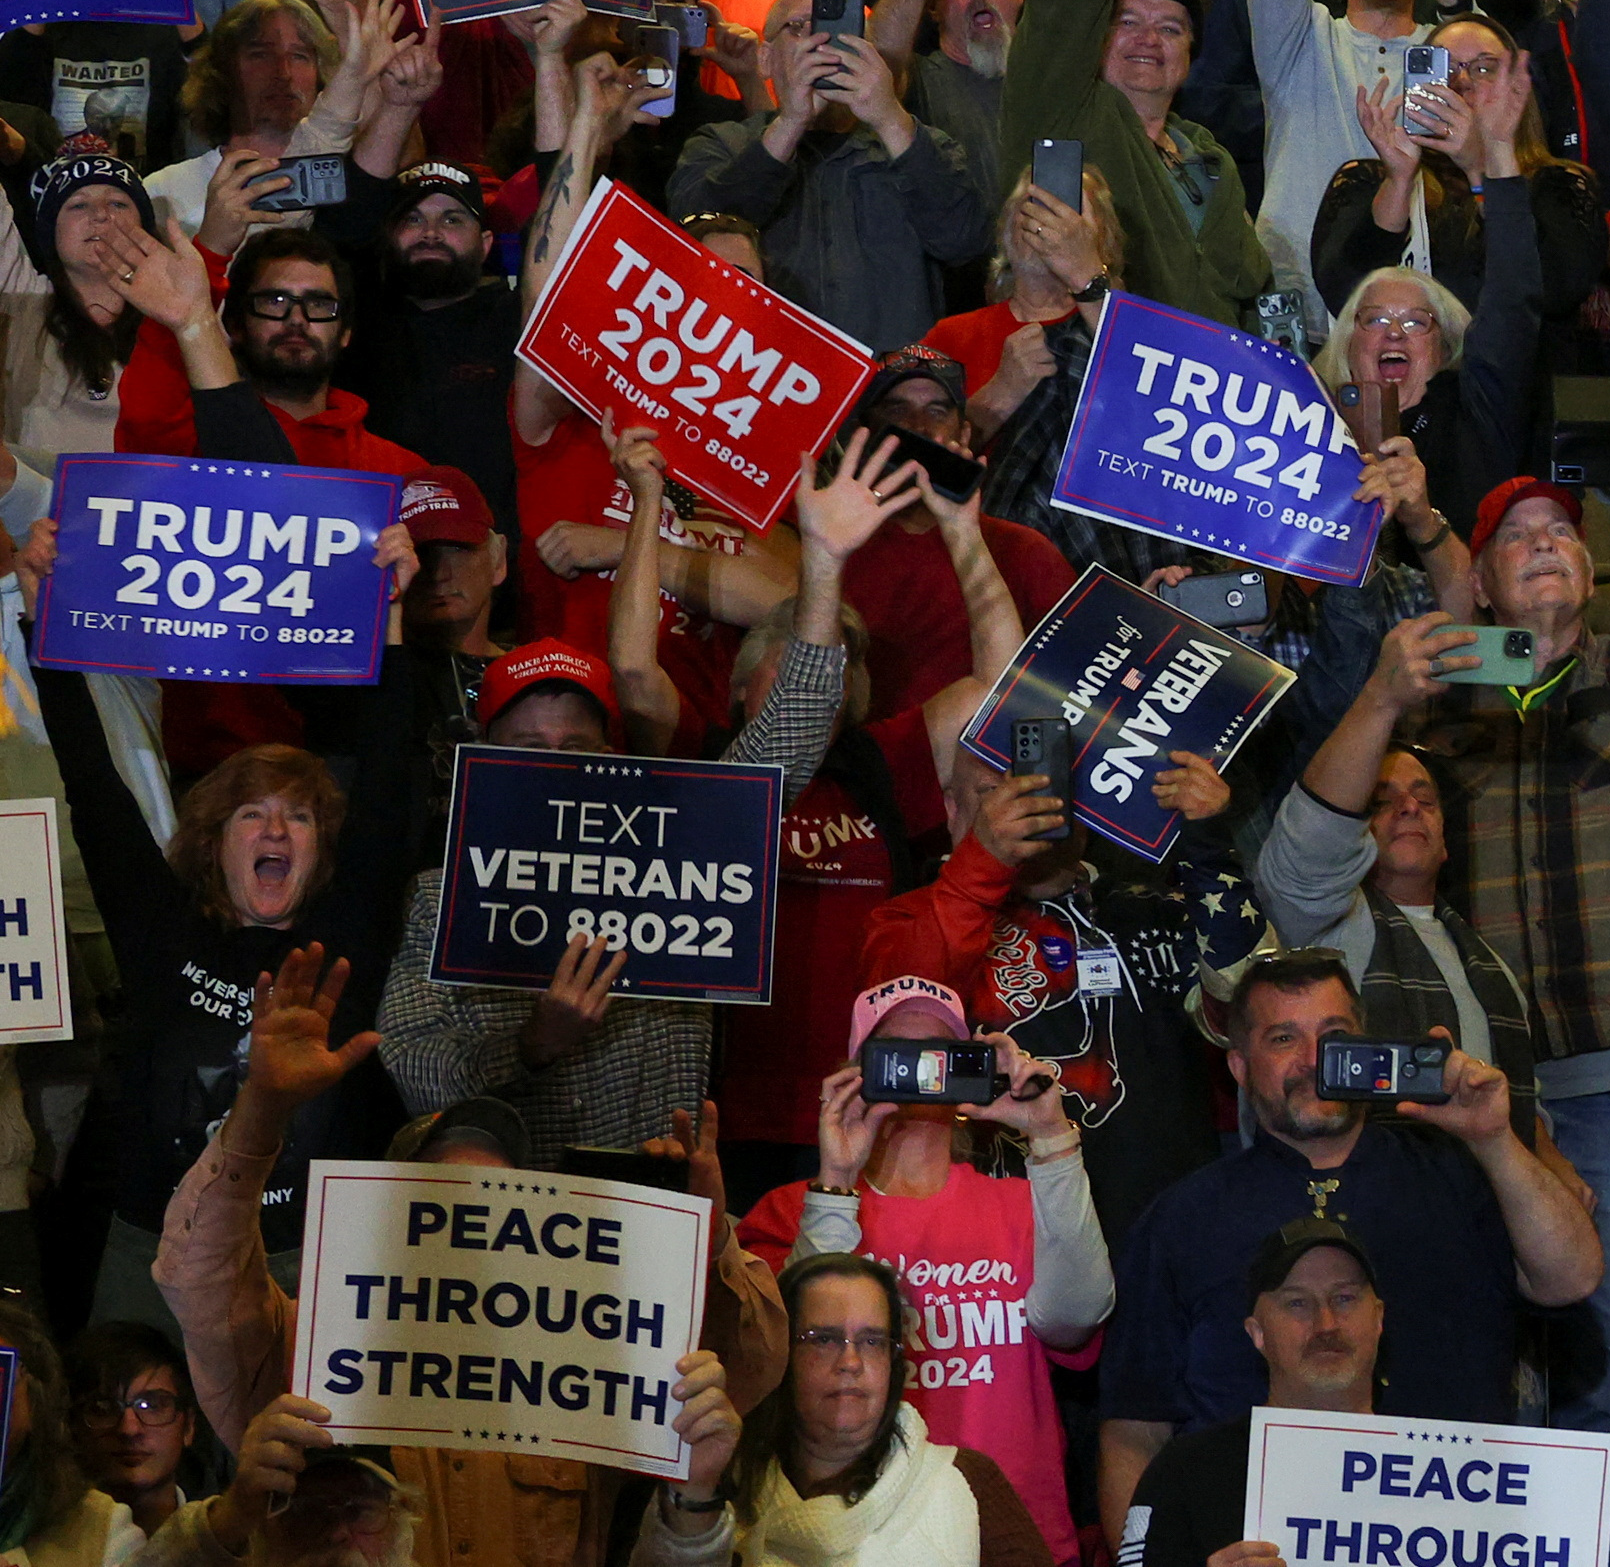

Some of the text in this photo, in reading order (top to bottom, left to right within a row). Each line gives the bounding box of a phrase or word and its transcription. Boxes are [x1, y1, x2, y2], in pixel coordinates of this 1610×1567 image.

[60, 63, 146, 81] WANTED
[55, 158, 133, 194] 2024
[397, 162, 471, 185] TRUMP
[606, 237, 822, 407] TRUMP
[597, 307, 764, 441] 2024
[560, 322, 771, 488] TEXT TRUMP TO 88022
[1142, 407, 1324, 502] 2024
[398, 504, 429, 522] TRUMP
[428, 501, 460, 510] TRAIN
[1097, 449, 1352, 542] TEXT TRUMP TO 88022
[86, 496, 362, 567] TRUMP
[115, 554, 314, 618] 2024
[69, 610, 356, 646] TEXT TRUMP TO 88022
[507, 652, 593, 675] MAKE AMERICA
[513, 663, 589, 680] GREAT AGAIN
[1061, 614, 1142, 726] for TRUMP
[1090, 635, 1234, 804] VETERANS
[548, 799, 678, 848] TEXT
[467, 845, 754, 905] VETERANS
[479, 901, 734, 959] TO 88022
[181, 960, 238, 1000] NEVER
[189, 990, 232, 1021] OUR
[866, 978, 953, 1006] TRUMP
[406, 1201, 623, 1267] PEACE
[344, 1274, 666, 1349] THROUGH
[323, 1347, 670, 1427] STRENGTH
[903, 1354, 995, 1390] 2024
[1341, 1450, 1531, 1507] PEACE
[1286, 1516, 1571, 1567] THROUGH
